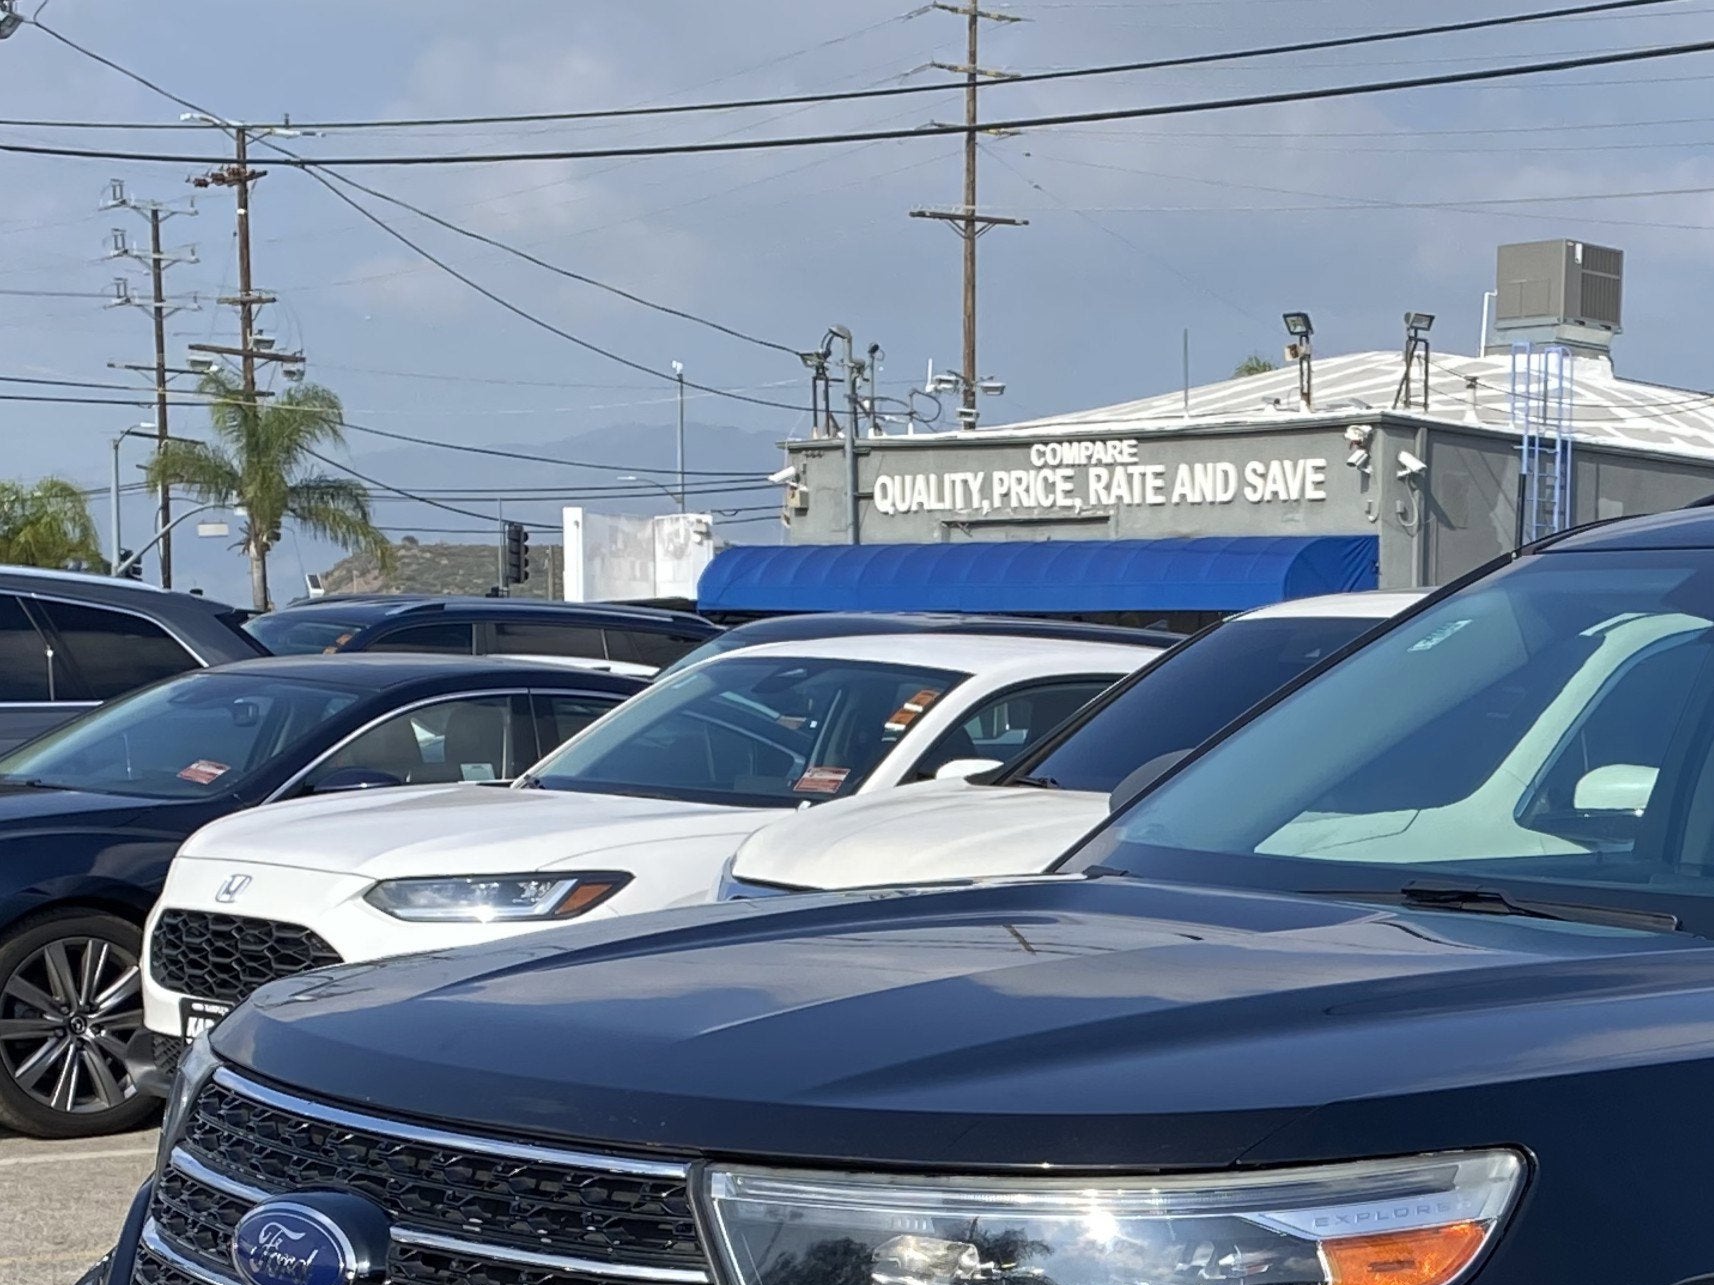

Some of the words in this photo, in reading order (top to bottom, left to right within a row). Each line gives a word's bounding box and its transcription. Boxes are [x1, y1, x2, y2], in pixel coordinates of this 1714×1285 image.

[1030, 439, 1139, 468] COMPARE
[873, 471, 991, 515] QUALITY,
[992, 468, 1082, 514] PRICE,
[1088, 465, 1167, 506] RATE
[1172, 461, 1238, 504] AND
[1243, 458, 1328, 503] SAVE
